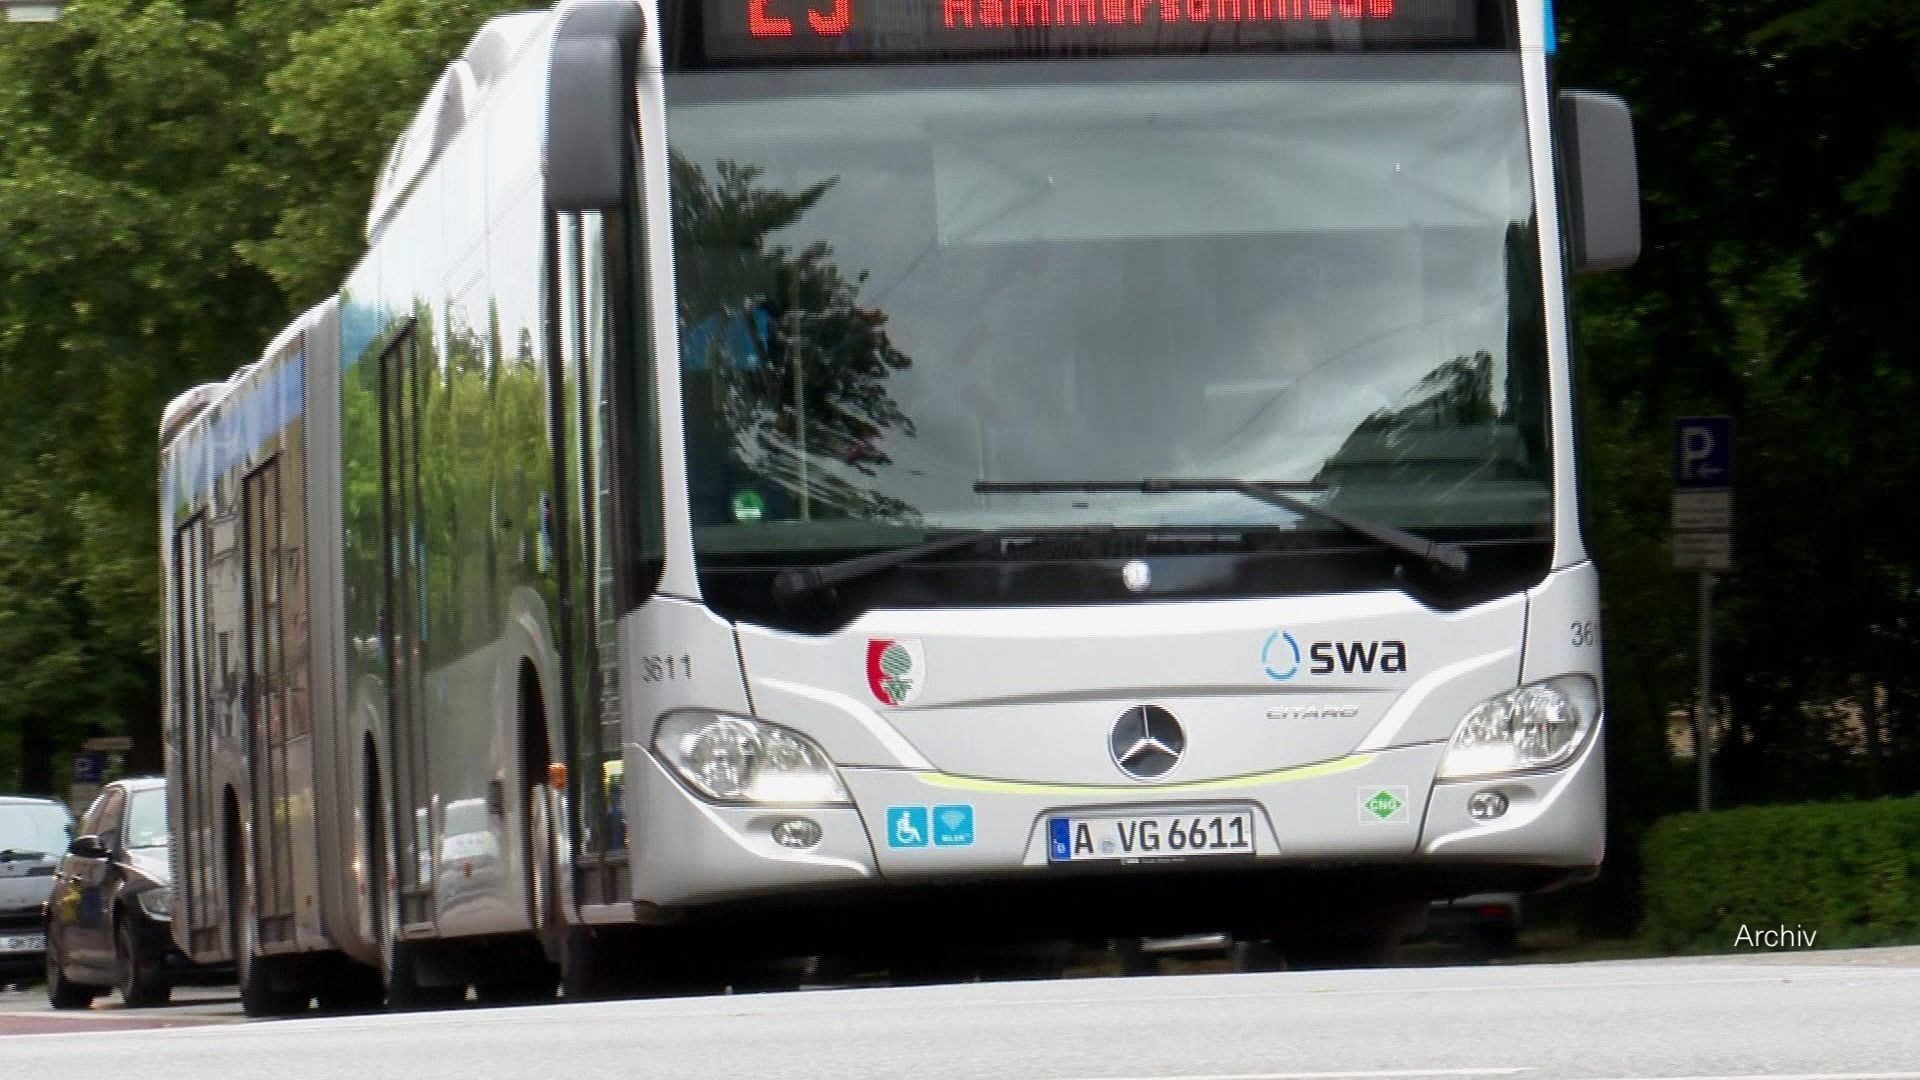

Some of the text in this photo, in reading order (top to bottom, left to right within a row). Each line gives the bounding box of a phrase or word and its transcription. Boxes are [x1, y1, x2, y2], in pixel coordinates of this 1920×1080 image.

[1679, 426, 1715, 480] P
[641, 653, 692, 683] 3611
[1310, 639, 1408, 675] swa
[1074, 816, 1248, 854] A VG 6611
